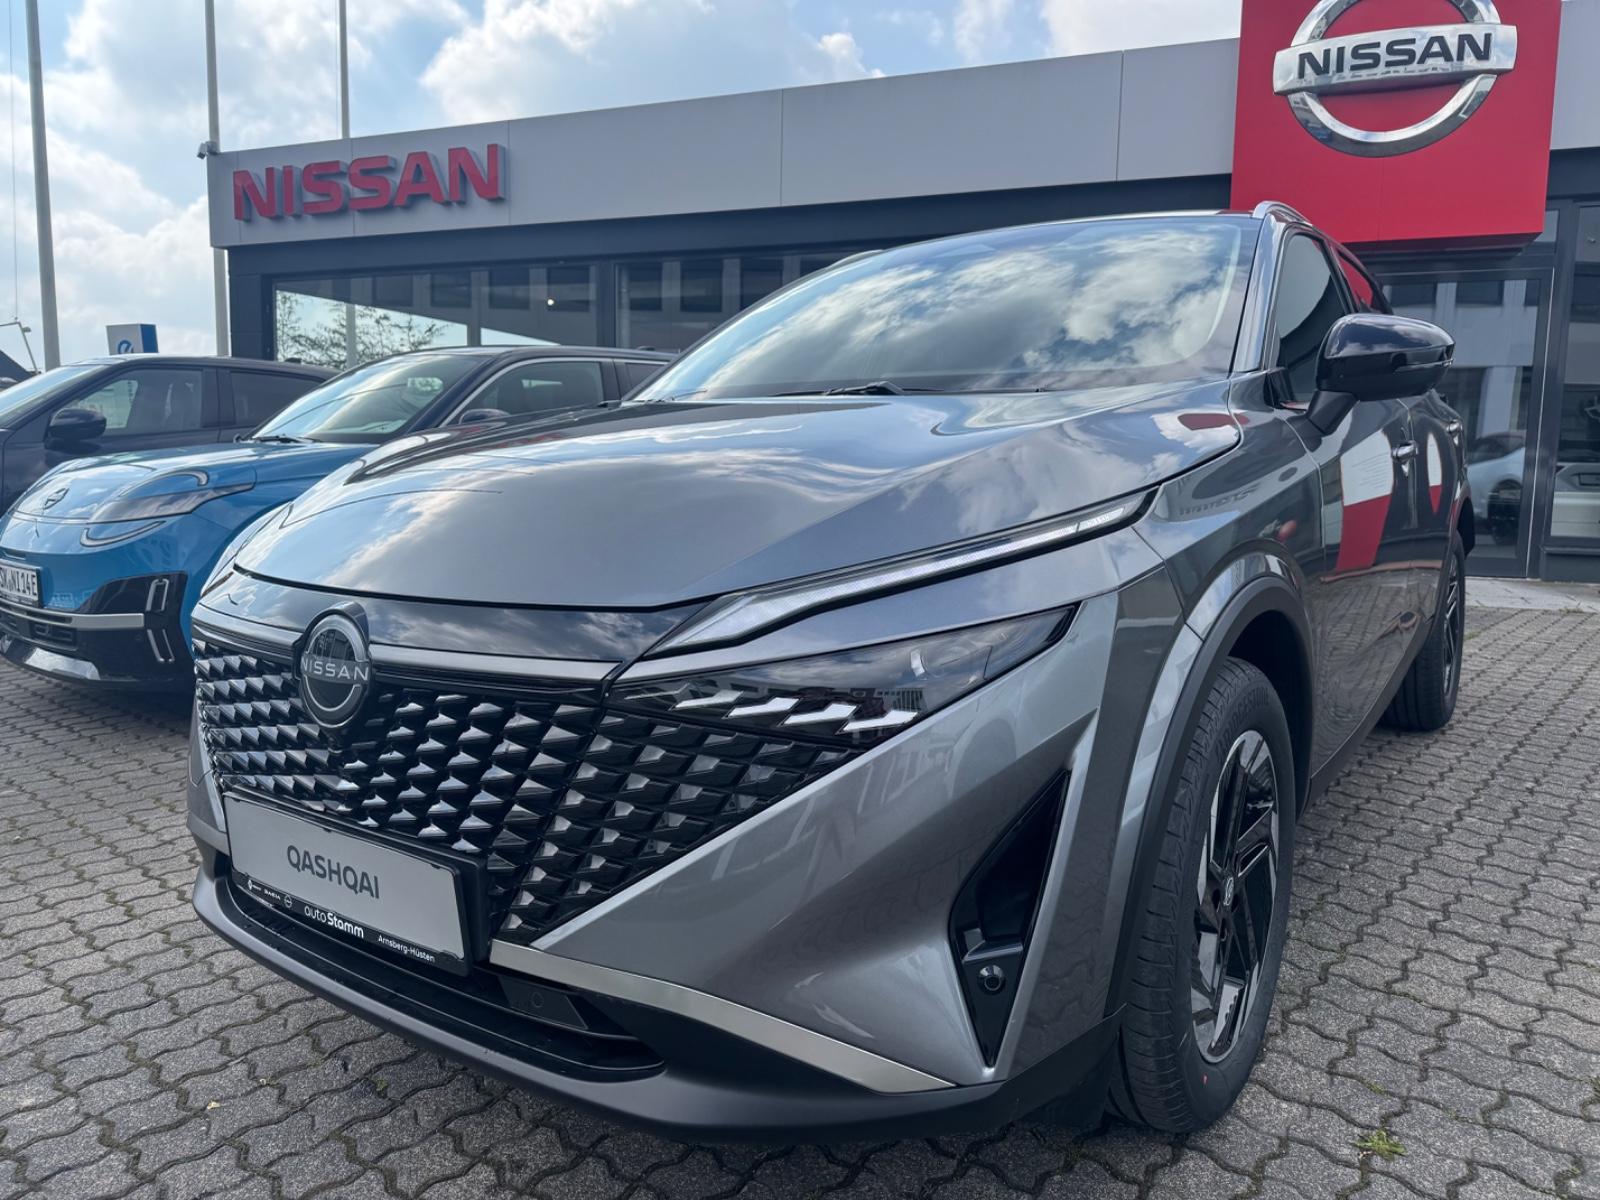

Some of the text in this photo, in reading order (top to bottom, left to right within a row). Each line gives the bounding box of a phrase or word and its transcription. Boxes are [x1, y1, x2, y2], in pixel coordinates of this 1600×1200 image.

[1297, 32, 1493, 80] NISSAN
[232, 143, 503, 221] NISSAN
[301, 656, 369, 681] NISSAN
[287, 844, 380, 899] QASHQAI
[378, 934, 436, 963] Arnsberg-Hüsten
